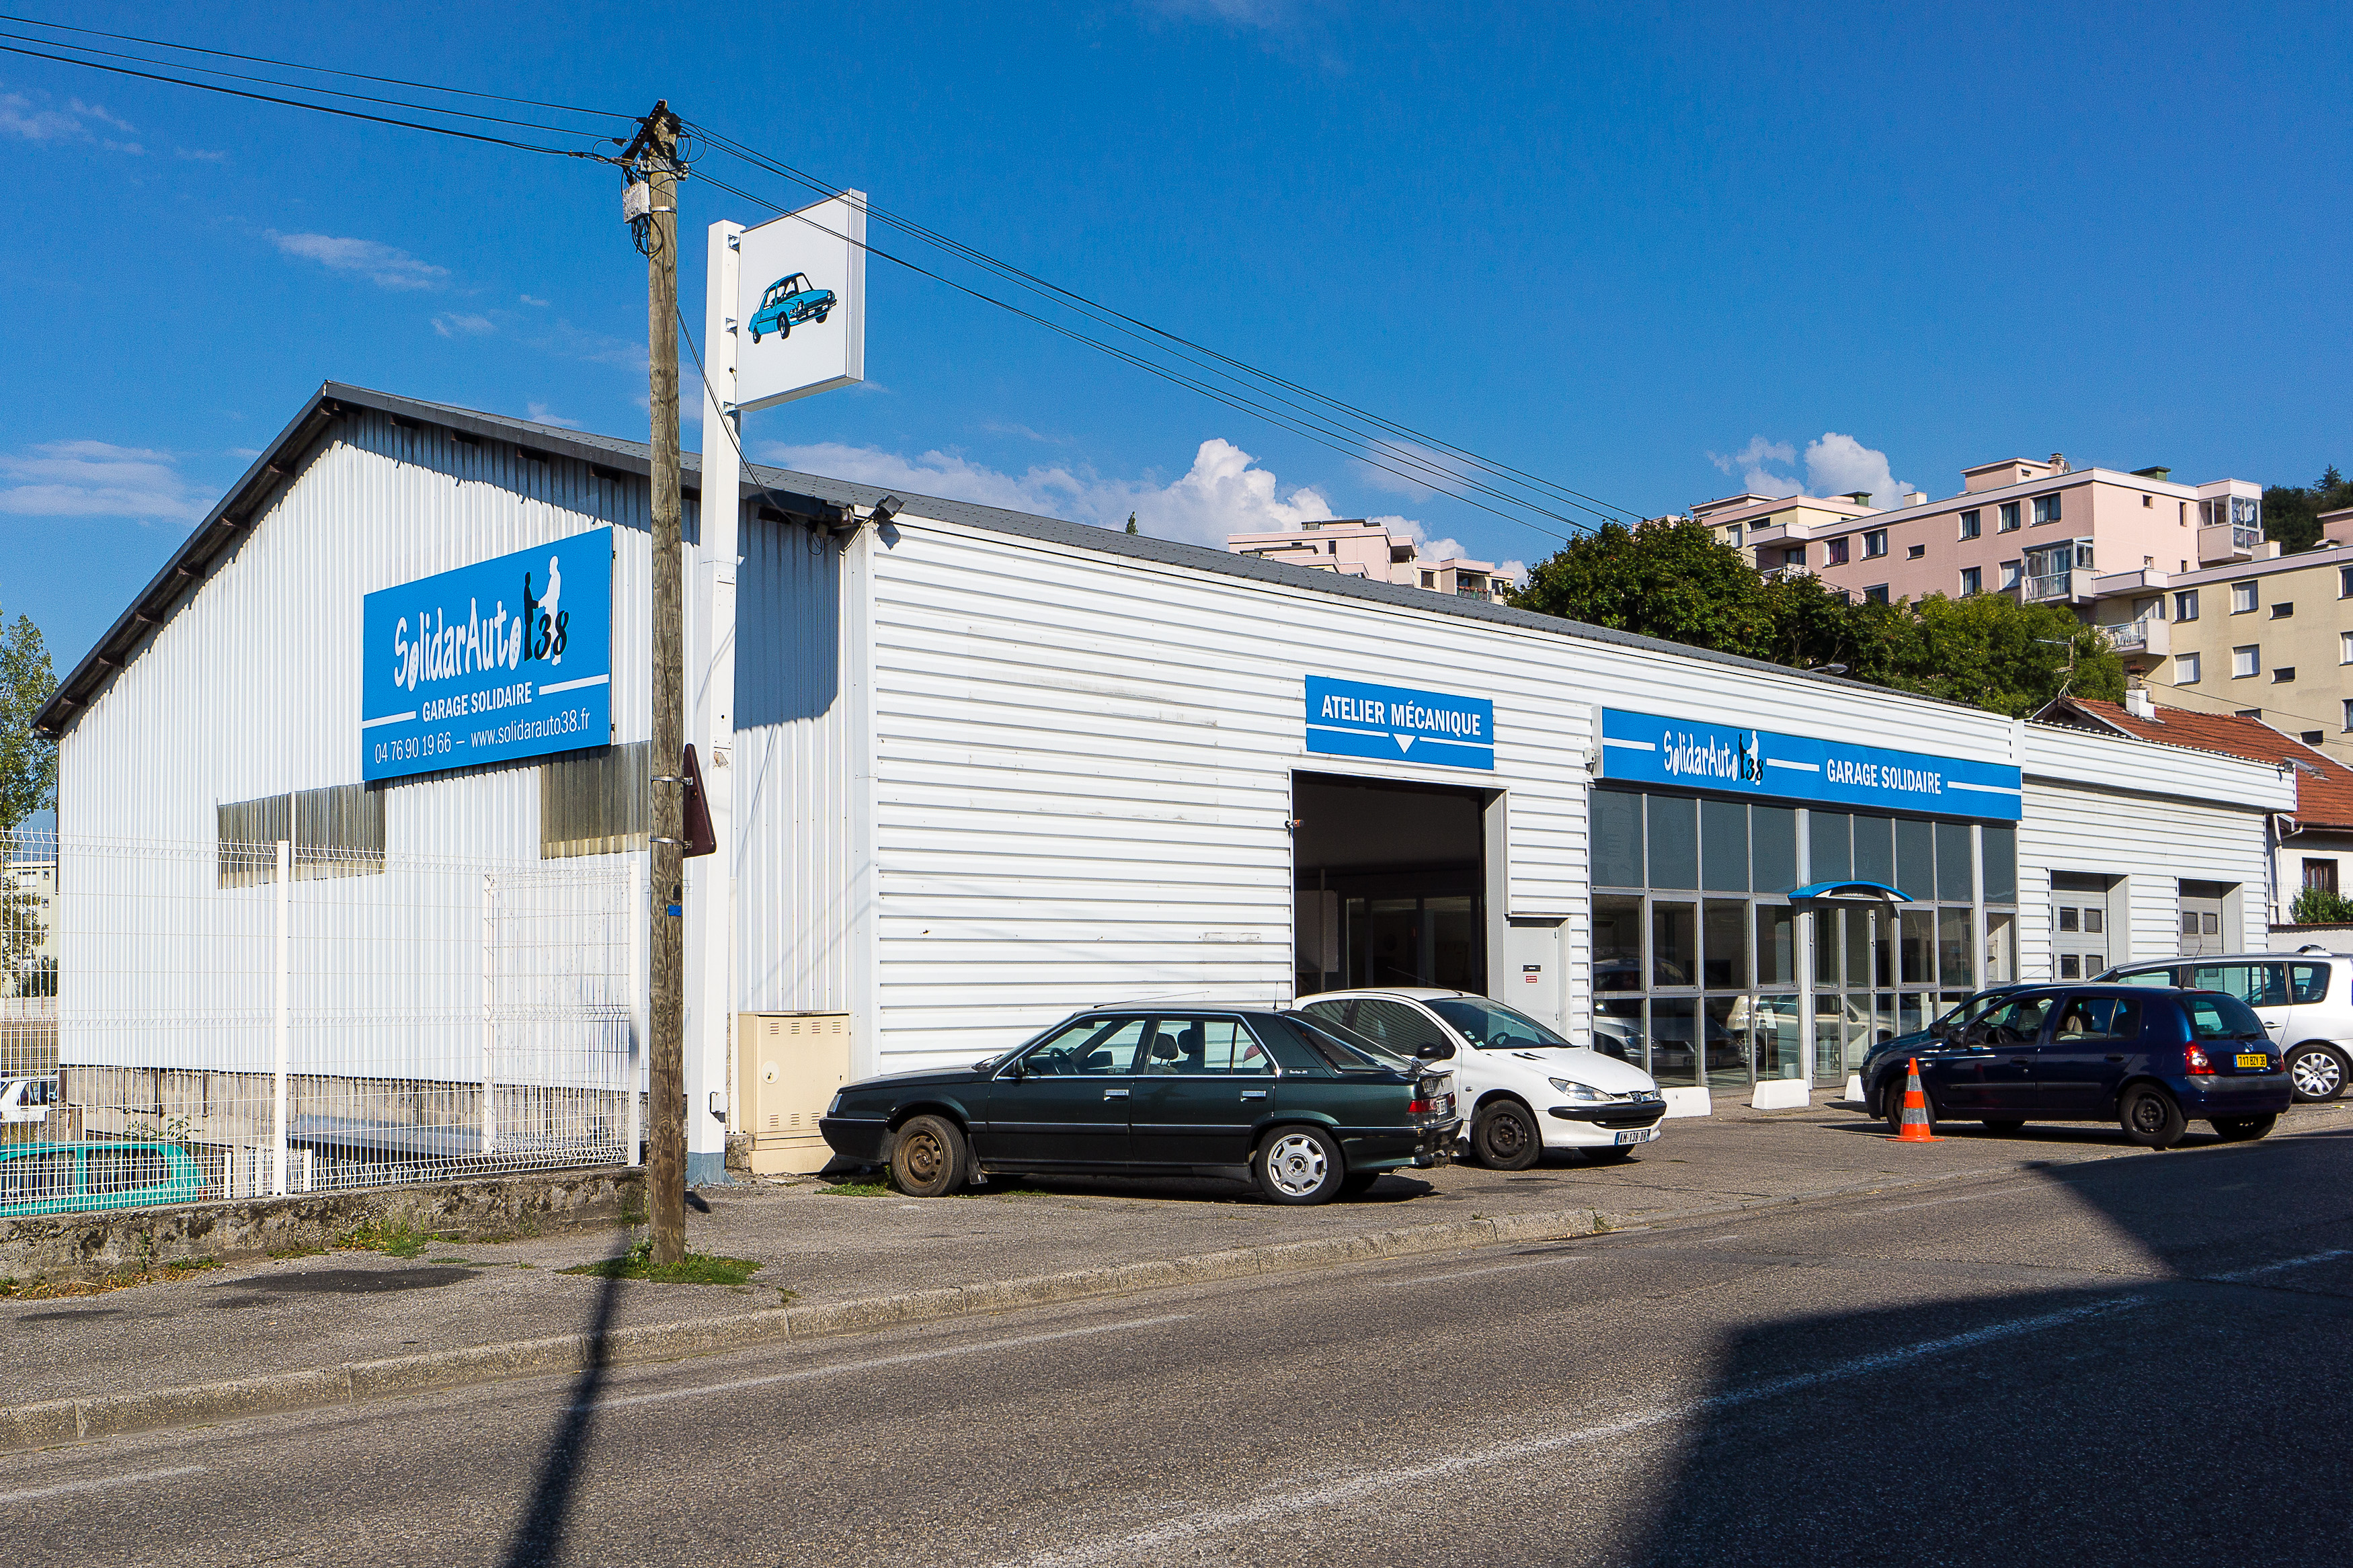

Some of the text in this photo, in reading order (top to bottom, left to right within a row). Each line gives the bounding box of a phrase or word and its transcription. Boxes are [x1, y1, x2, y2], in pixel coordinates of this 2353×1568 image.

[422, 681, 532, 722] GARAGE SOLIDAIRE
[1321, 694, 1482, 738] ATELIER MÉCANIQUE
[374, 742, 389, 764] 04
[391, 739, 403, 761] 76
[405, 737, 420, 758] 90
[422, 734, 434, 756] 19
[437, 731, 451, 753] 66
[471, 708, 590, 748] www.solidarauto38.fr
[1827, 758, 1942, 794] GARAGE SOLIDAIRE
